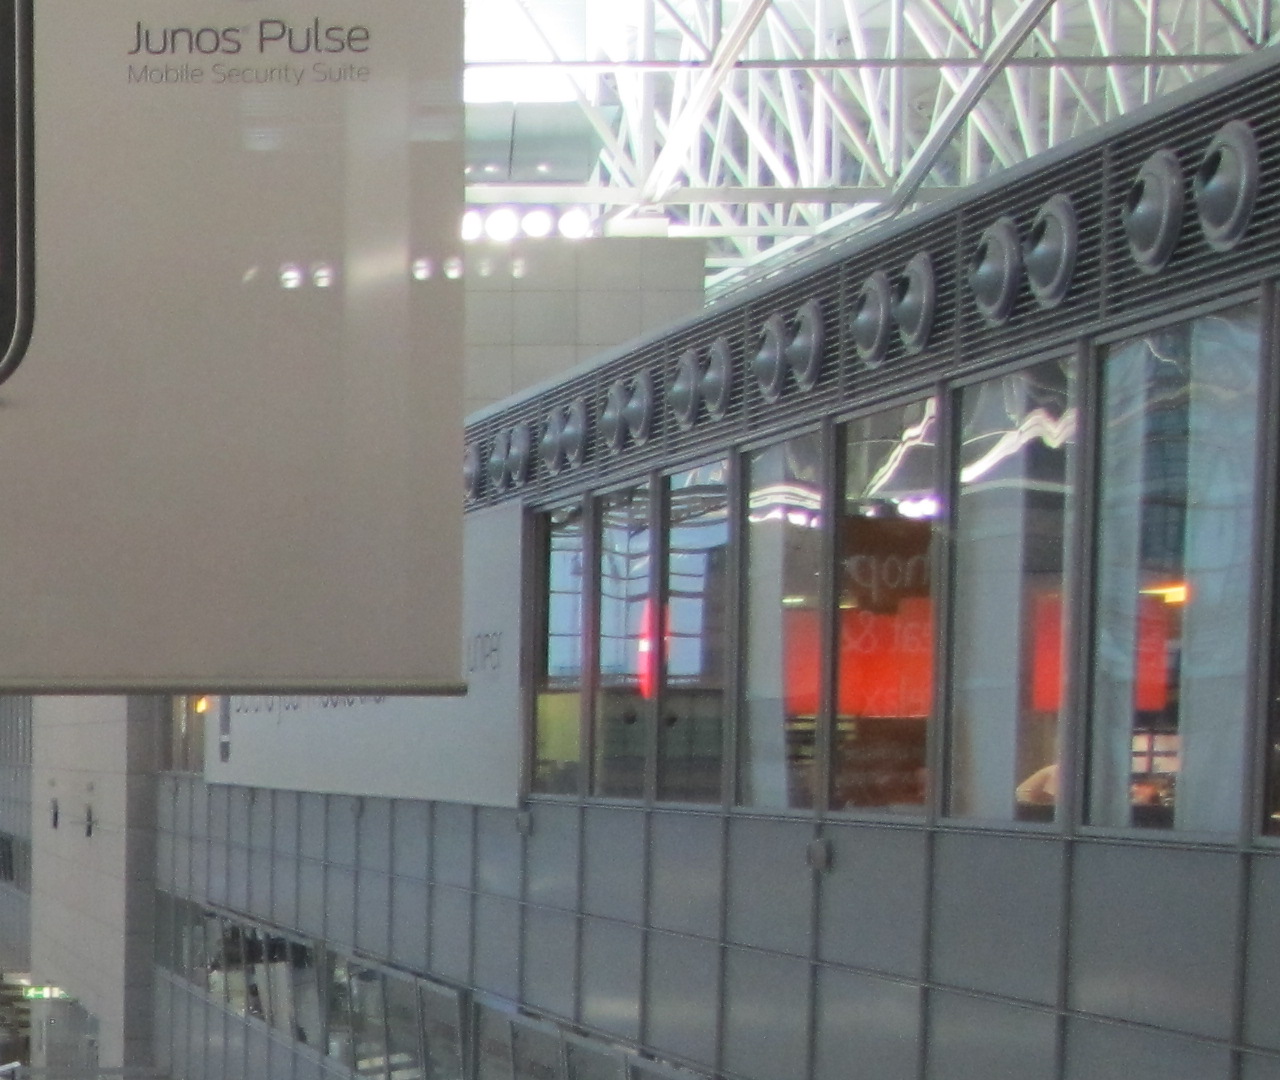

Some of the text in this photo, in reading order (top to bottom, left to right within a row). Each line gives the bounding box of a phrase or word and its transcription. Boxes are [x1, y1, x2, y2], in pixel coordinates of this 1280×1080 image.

[127, 17, 371, 55] Junos Pulse
[127, 61, 372, 88] Mobile Security Suite
